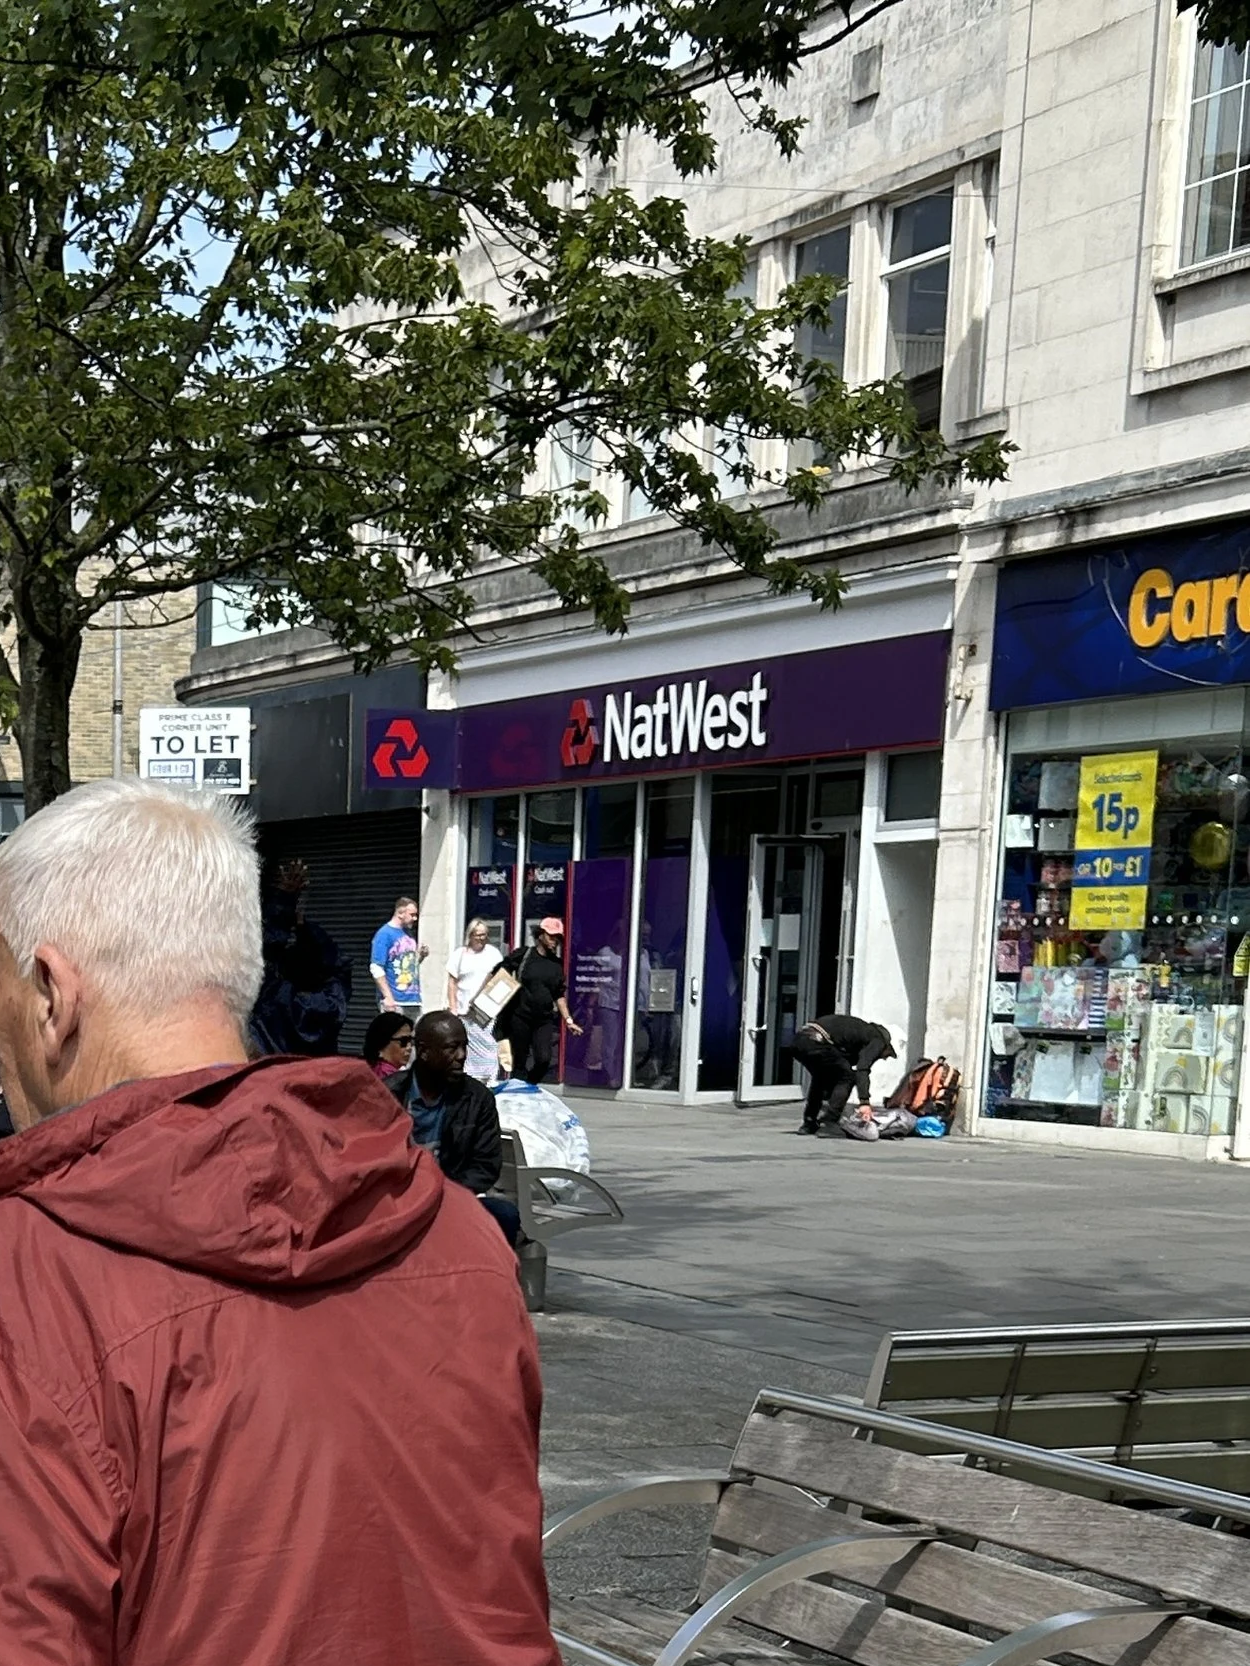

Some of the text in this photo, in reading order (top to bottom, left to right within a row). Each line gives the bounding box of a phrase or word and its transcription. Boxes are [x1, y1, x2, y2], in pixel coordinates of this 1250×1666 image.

[191, 713, 222, 721] CLASS
[603, 671, 768, 763] NatWest
[162, 724, 201, 732] CORNER
[150, 735, 240, 754] TO LET
[1092, 792, 1139, 839] 15p
[534, 867, 564, 881] NatWest
[1093, 857, 1113, 878] 10
[1125, 856, 1143, 877] £1
[479, 870, 507, 884] NatWest
